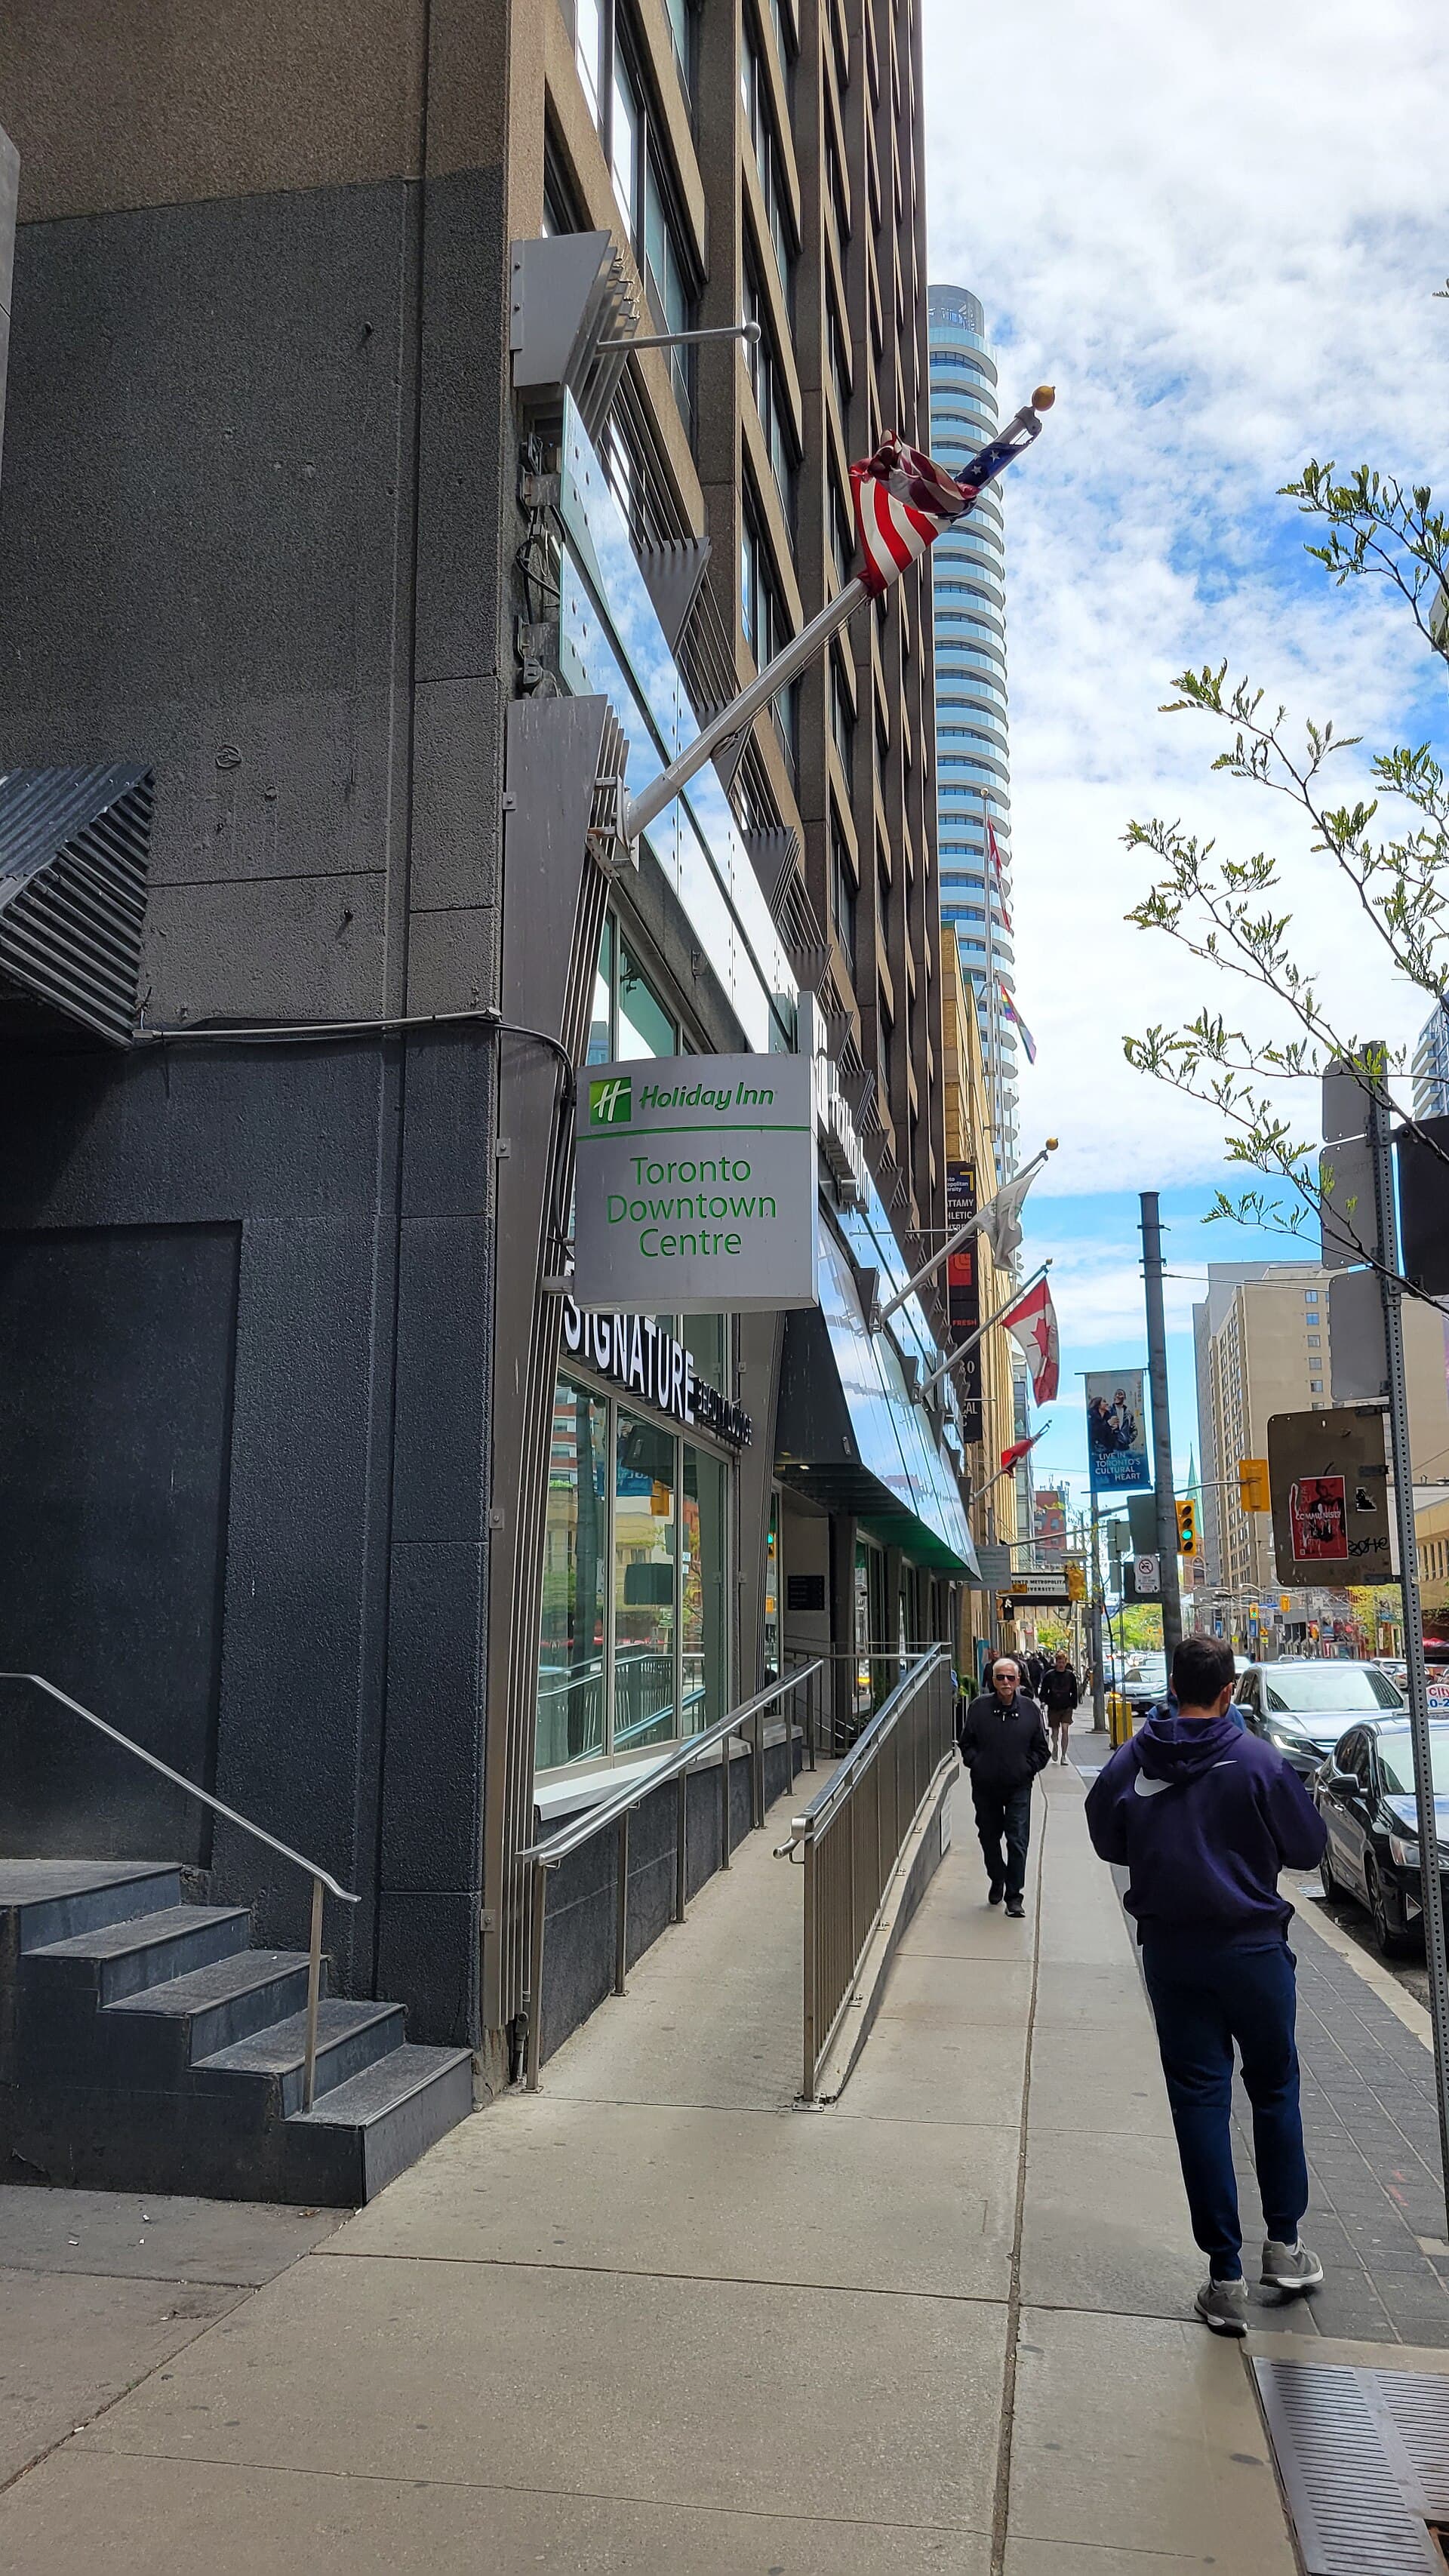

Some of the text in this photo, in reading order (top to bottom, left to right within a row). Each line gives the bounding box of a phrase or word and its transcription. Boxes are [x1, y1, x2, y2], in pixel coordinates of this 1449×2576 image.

[639, 1082, 774, 1110] Holiday Inn
[630, 1157, 751, 1185] Toronto
[607, 1193, 777, 1223] Downtown
[639, 1229, 742, 1257] Centre
[1096, 1458, 1140, 1468] TORONTO'S
[1099, 1452, 1115, 1460] LIVE
[1115, 1473, 1141, 1481] HEART
